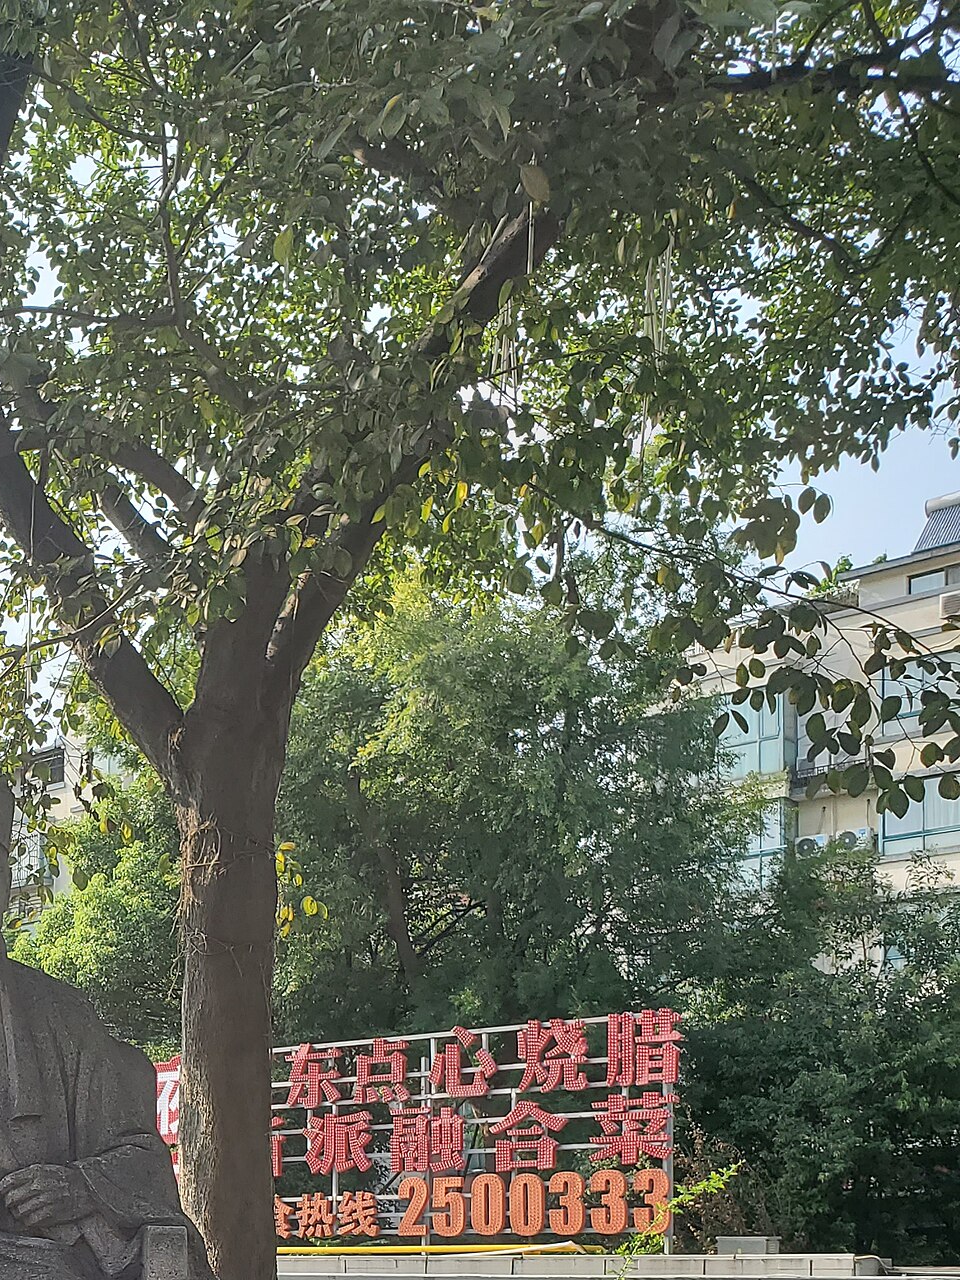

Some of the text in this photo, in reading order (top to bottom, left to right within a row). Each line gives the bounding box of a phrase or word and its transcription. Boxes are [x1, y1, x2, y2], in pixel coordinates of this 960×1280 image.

[285, 1007, 683, 1109] 东点心烧腊
[271, 1091, 680, 1177] 派融合菜
[397, 1168, 673, 1238] 2500333
